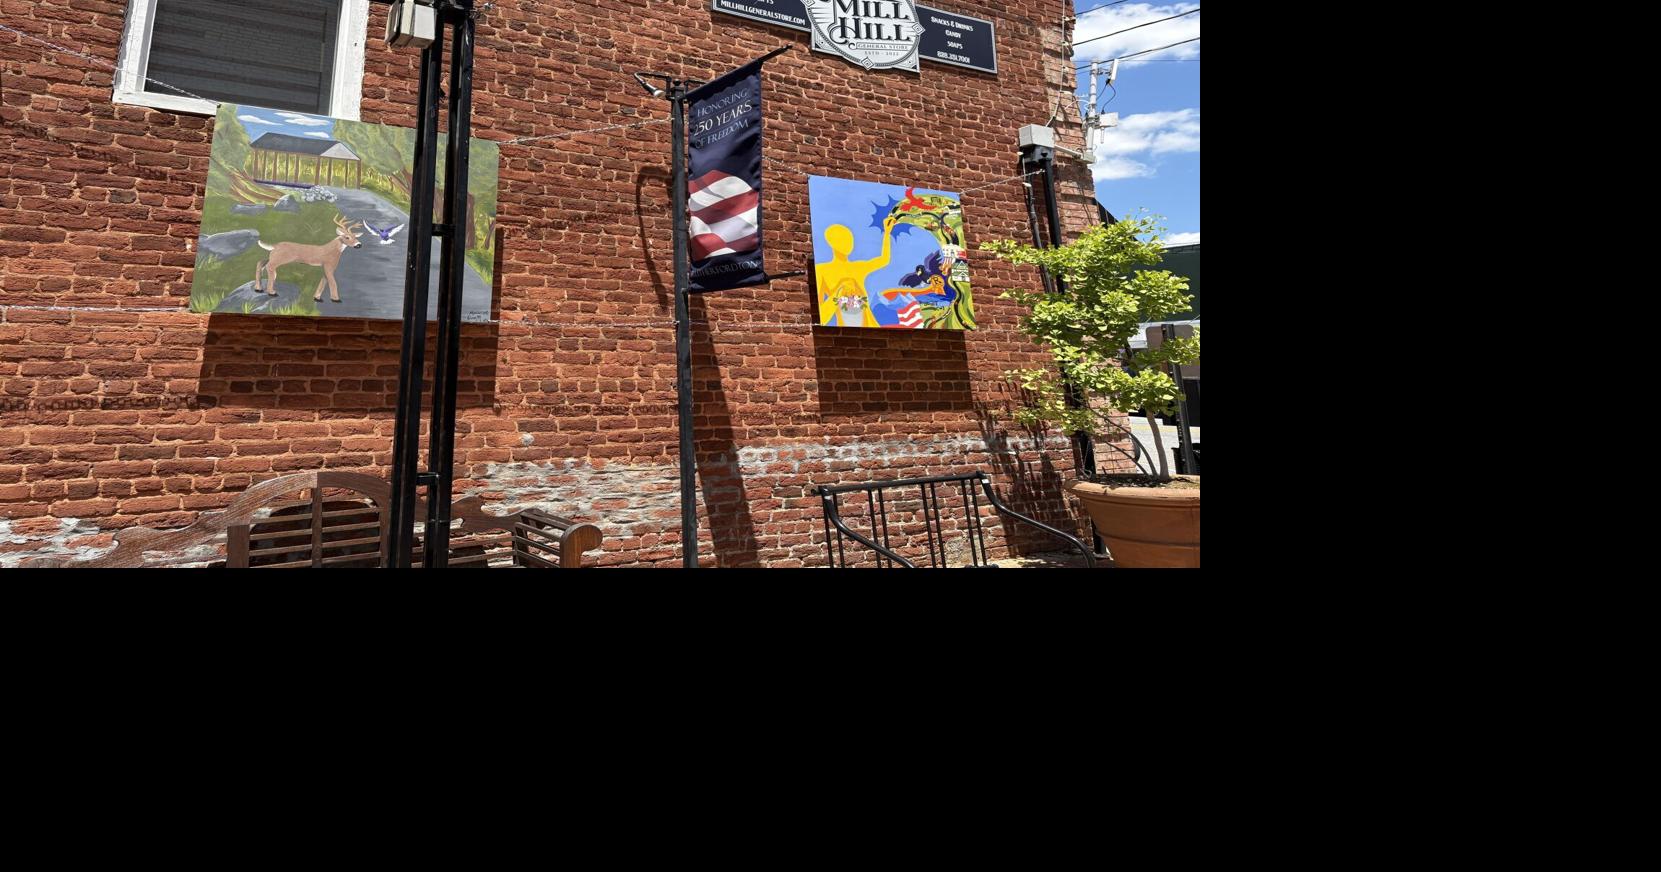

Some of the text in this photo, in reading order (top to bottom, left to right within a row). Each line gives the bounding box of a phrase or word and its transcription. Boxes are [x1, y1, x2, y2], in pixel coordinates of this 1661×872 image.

[720, 1, 805, 25] MILLHILLGENERALSTORE.COM
[836, 0, 910, 19] MILL
[830, 17, 911, 44] HILL
[697, 88, 750, 117] HONORING
[693, 100, 752, 136] 250 YEARS
[707, 119, 749, 144] FREEDOM
